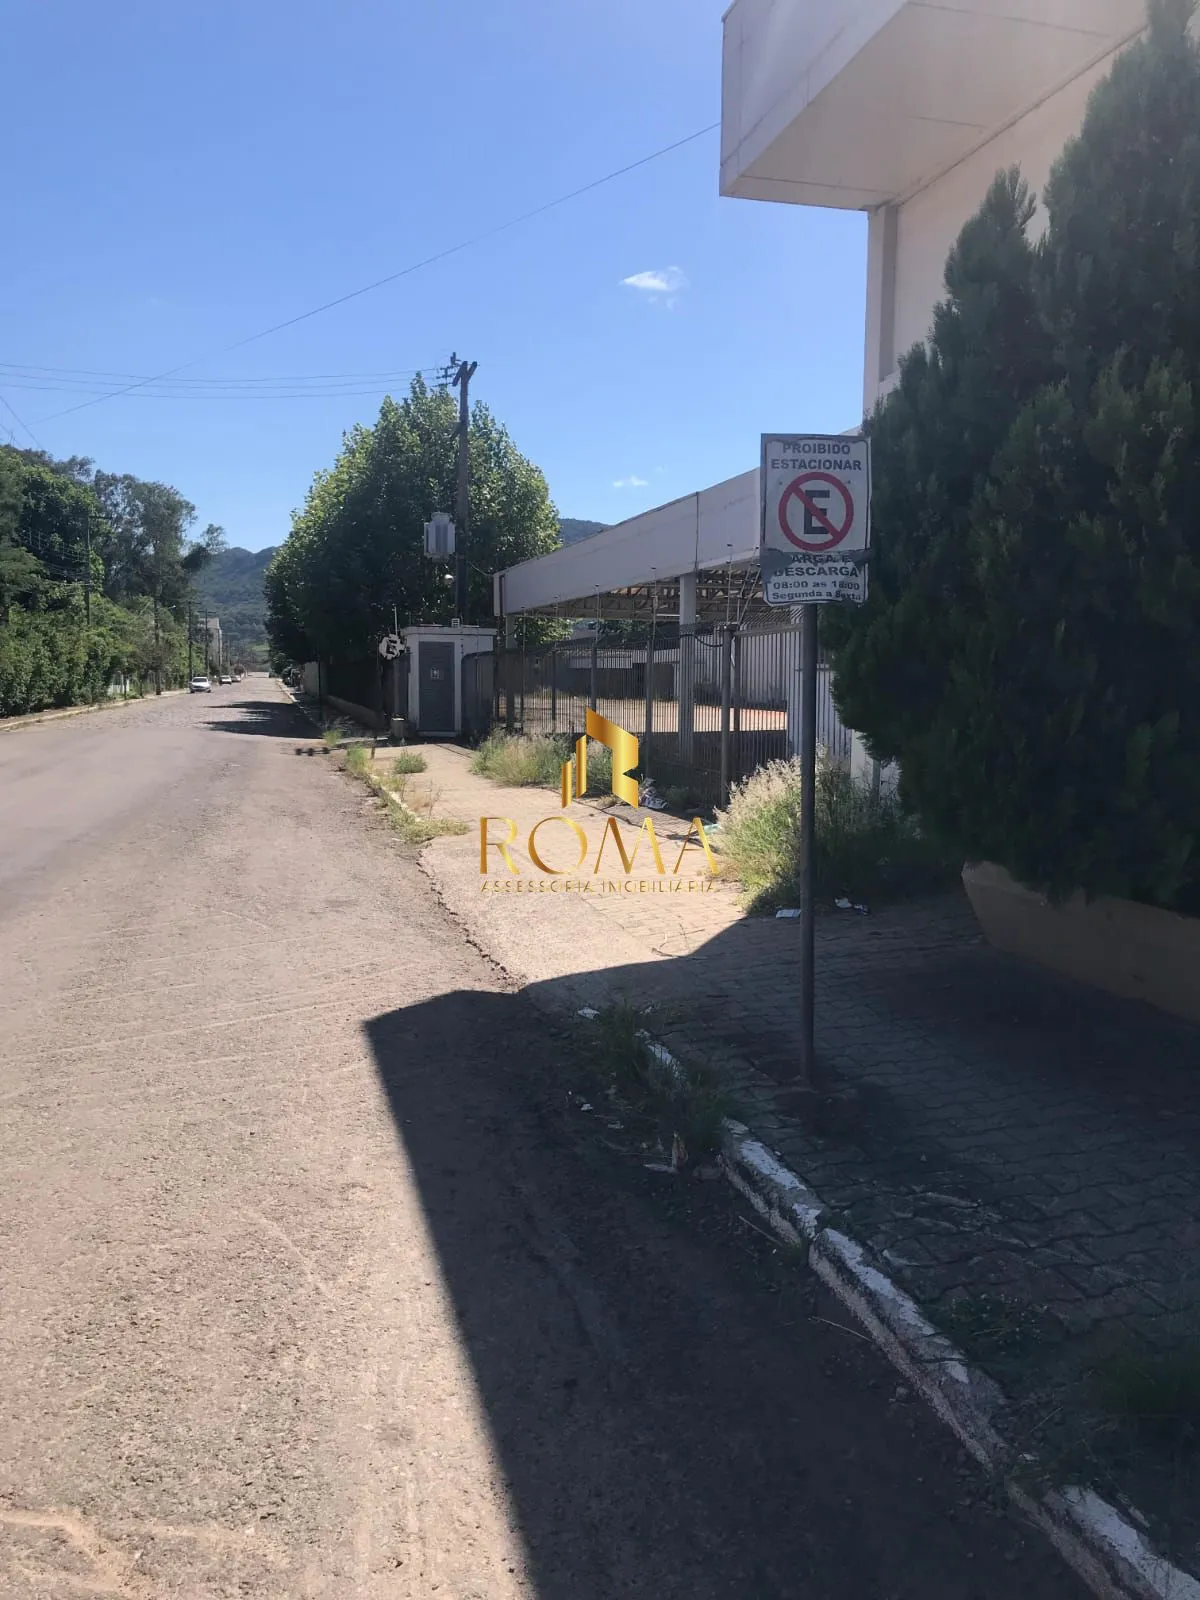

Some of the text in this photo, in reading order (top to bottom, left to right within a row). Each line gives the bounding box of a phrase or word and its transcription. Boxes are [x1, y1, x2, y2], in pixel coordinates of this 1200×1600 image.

[783, 443, 850, 454] PROIBIDO
[771, 459, 862, 470] ESTACIONAR
[789, 555, 837, 565] ARGA
[773, 581, 809, 590] 08:00
[772, 590, 823, 600] Segunda
